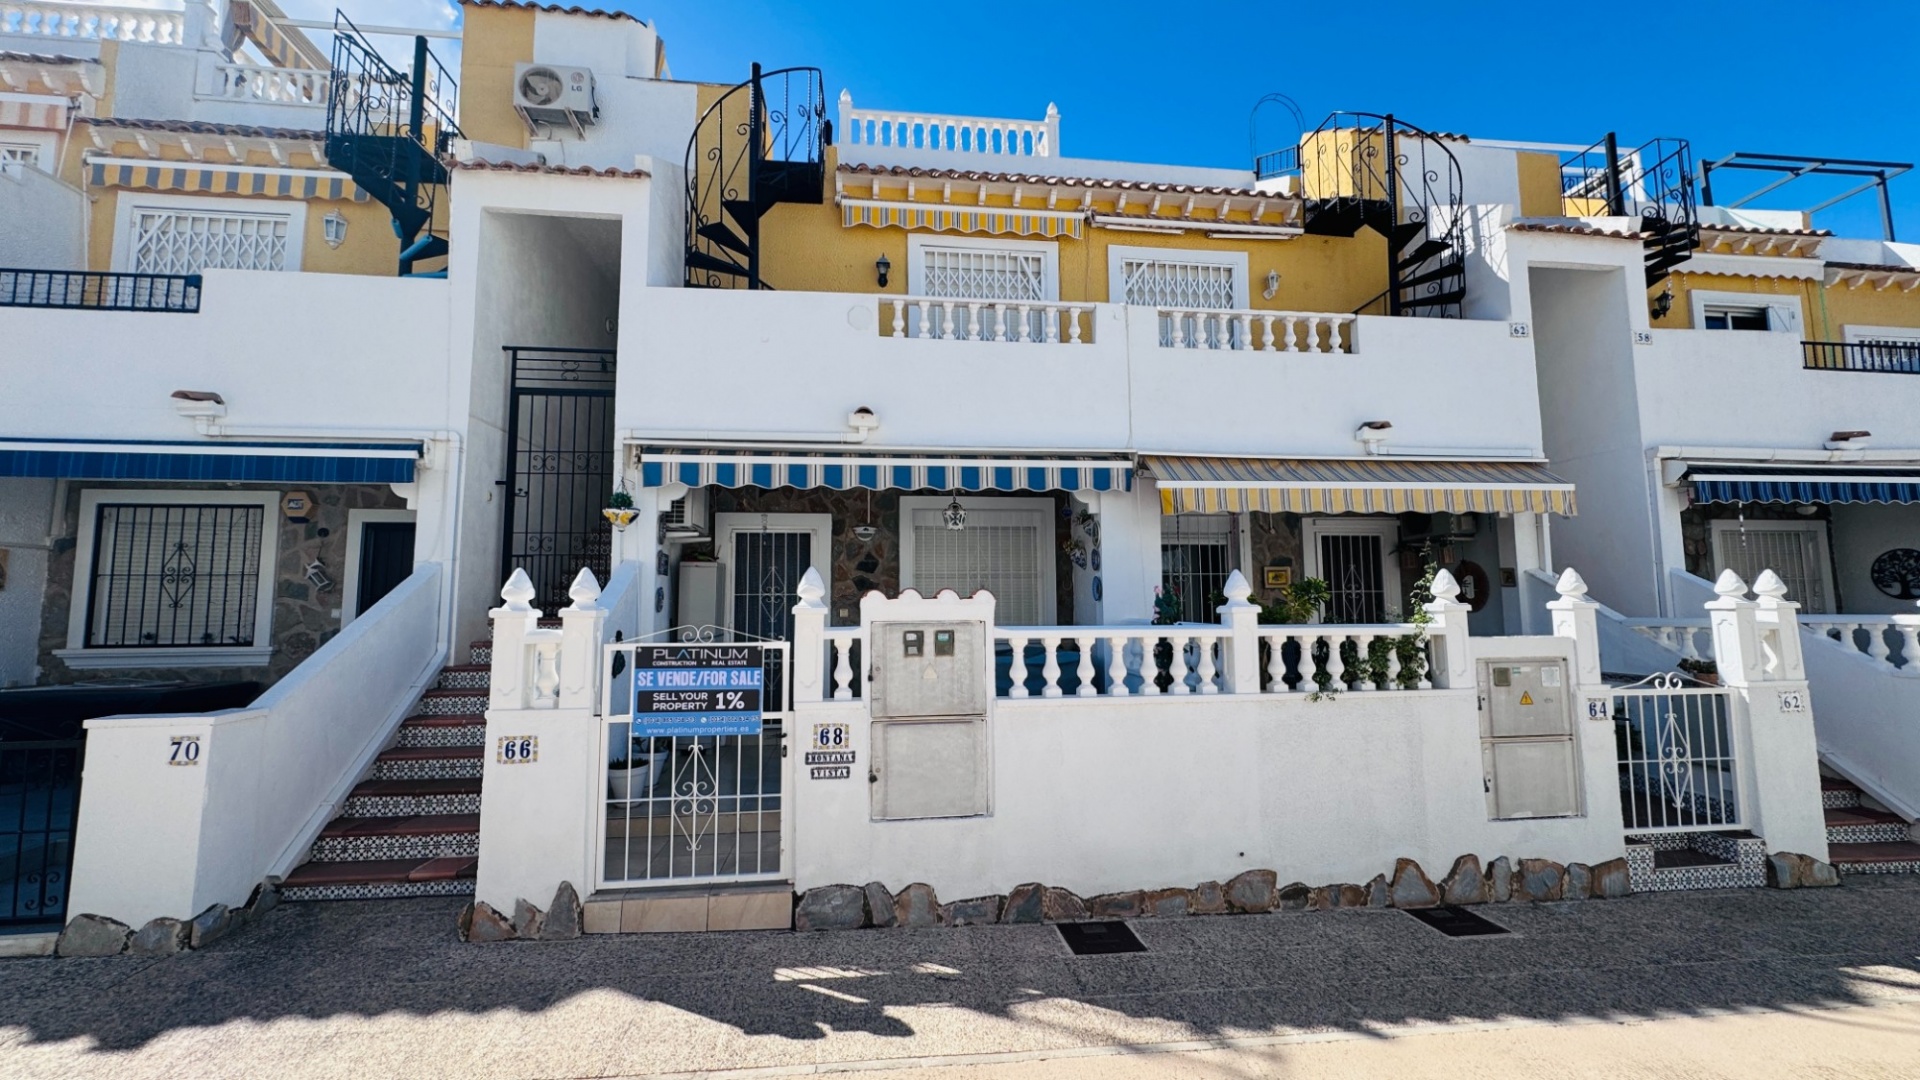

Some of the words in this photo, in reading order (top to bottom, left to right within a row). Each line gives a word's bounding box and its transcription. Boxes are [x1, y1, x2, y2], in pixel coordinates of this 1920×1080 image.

[1513, 325, 1526, 335] 62
[1637, 332, 1650, 343] 58
[652, 648, 748, 660] PLATINUM
[637, 671, 654, 687] SE
[657, 670, 727, 687] VENDE/FOR
[730, 670, 761, 686] SALE
[652, 692, 678, 701] SELL
[679, 692, 709, 701] YOUR
[715, 691, 745, 710] 1%
[1783, 695, 1800, 709] 62
[652, 702, 708, 711] PROPERTY
[1588, 701, 1608, 718] 64
[646, 726, 749, 735] www.platinumproperties.es
[819, 727, 843, 746] 68
[169, 741, 200, 761] 70
[504, 739, 532, 760] 66
[816, 769, 845, 777] VISTA
